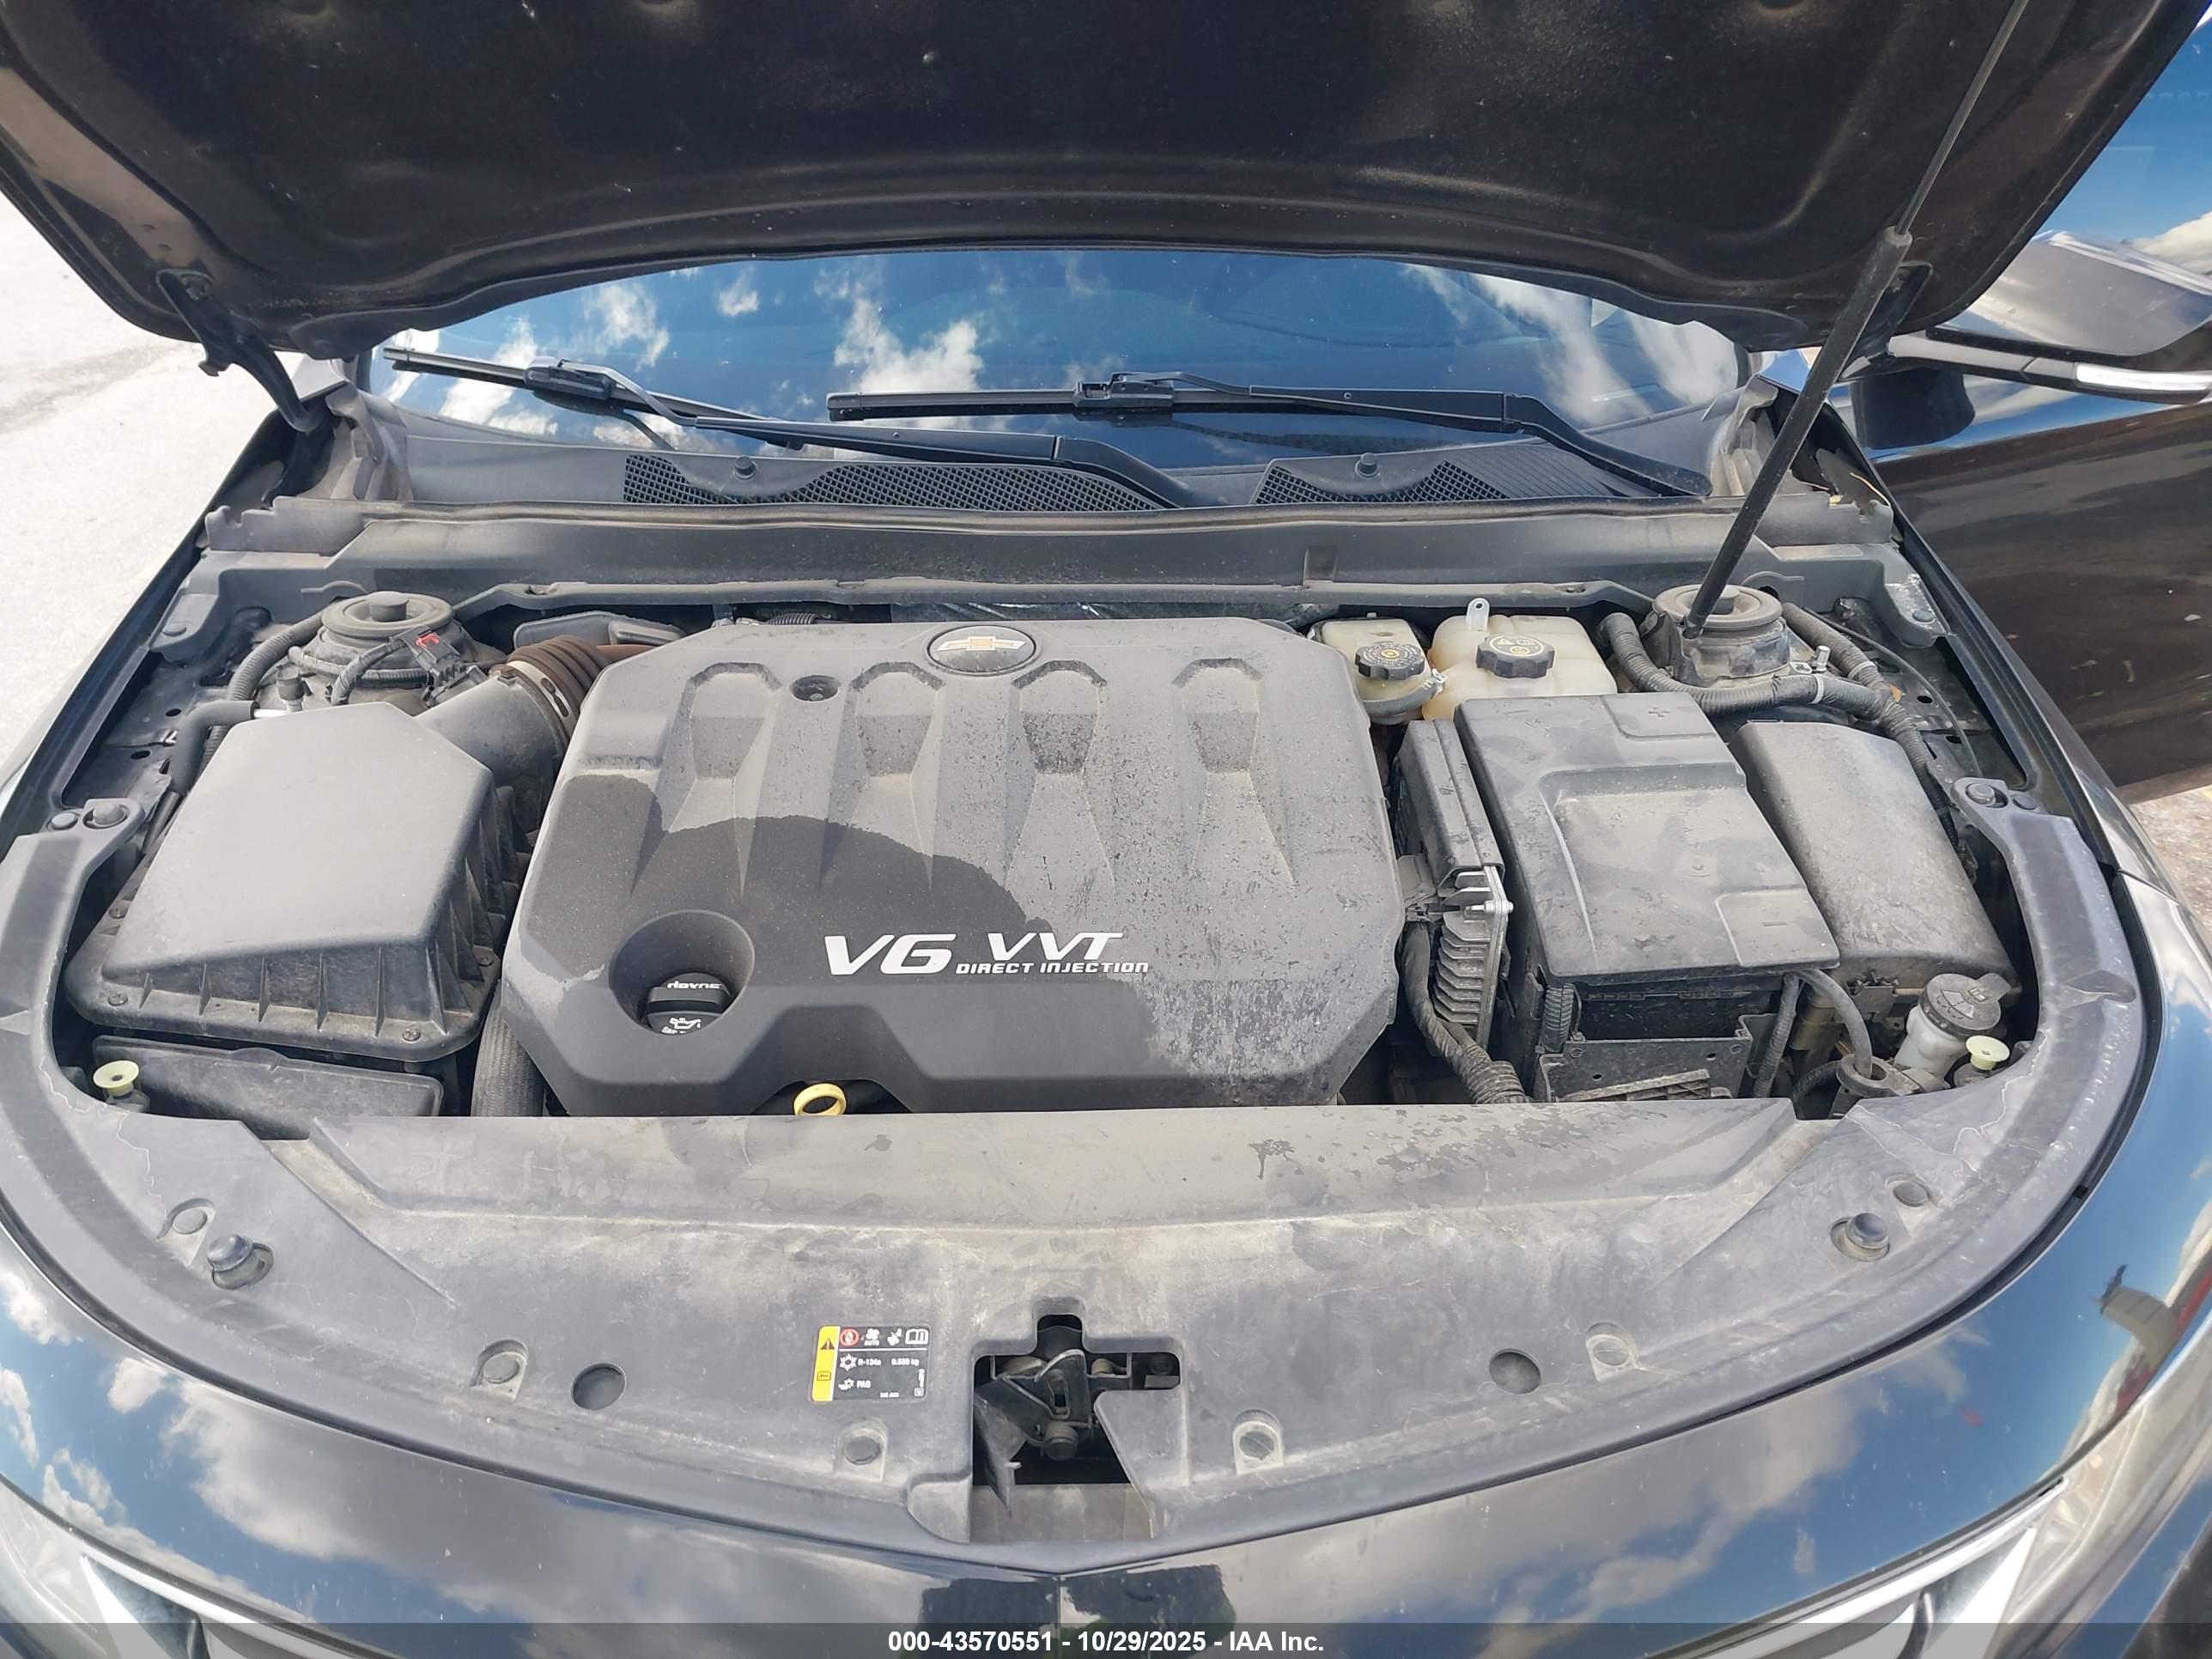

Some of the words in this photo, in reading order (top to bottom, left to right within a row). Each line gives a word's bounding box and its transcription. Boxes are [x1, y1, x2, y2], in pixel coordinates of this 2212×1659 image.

[824, 933, 957, 975] V6
[988, 932, 1124, 961] VVT
[955, 963, 1035, 975] DIRECT
[1040, 962, 1149, 975] INJECTION
